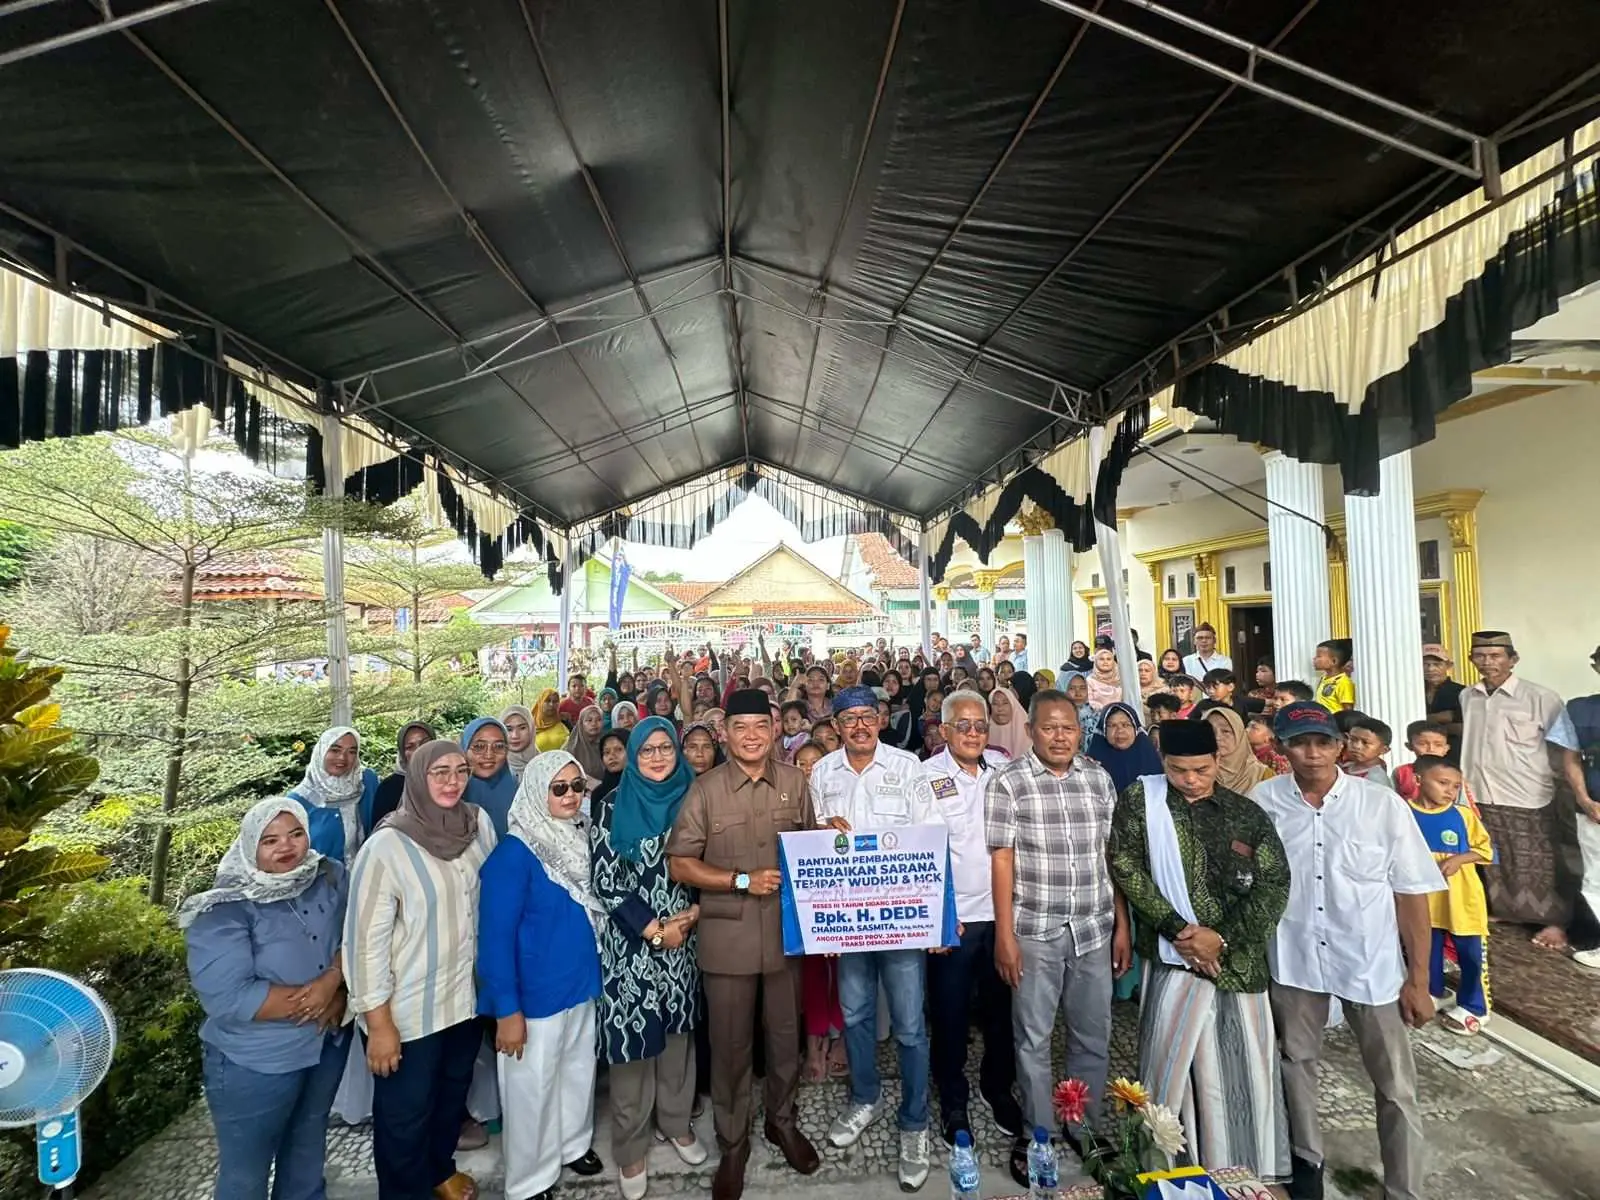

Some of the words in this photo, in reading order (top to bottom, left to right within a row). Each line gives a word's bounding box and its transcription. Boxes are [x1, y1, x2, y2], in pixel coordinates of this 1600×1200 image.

[798, 856, 849, 866] BANTUAN
[852, 852, 934, 863] PEMBANGUNAN
[798, 866, 877, 878] PERBAIKAN
[881, 862, 937, 874] SARANA
[794, 878, 844, 889] TEMPAT
[849, 875, 898, 887] WUDHU
[902, 875, 910, 884] &
[914, 873, 942, 883] MCK
[815, 911, 852, 925] Bpk.
[857, 909, 875, 921] H.
[880, 906, 929, 919] DEDE
[811, 925, 854, 933] CHANDRA
[857, 924, 898, 932] SASMITA,
[845, 933, 864, 941] DPRD
